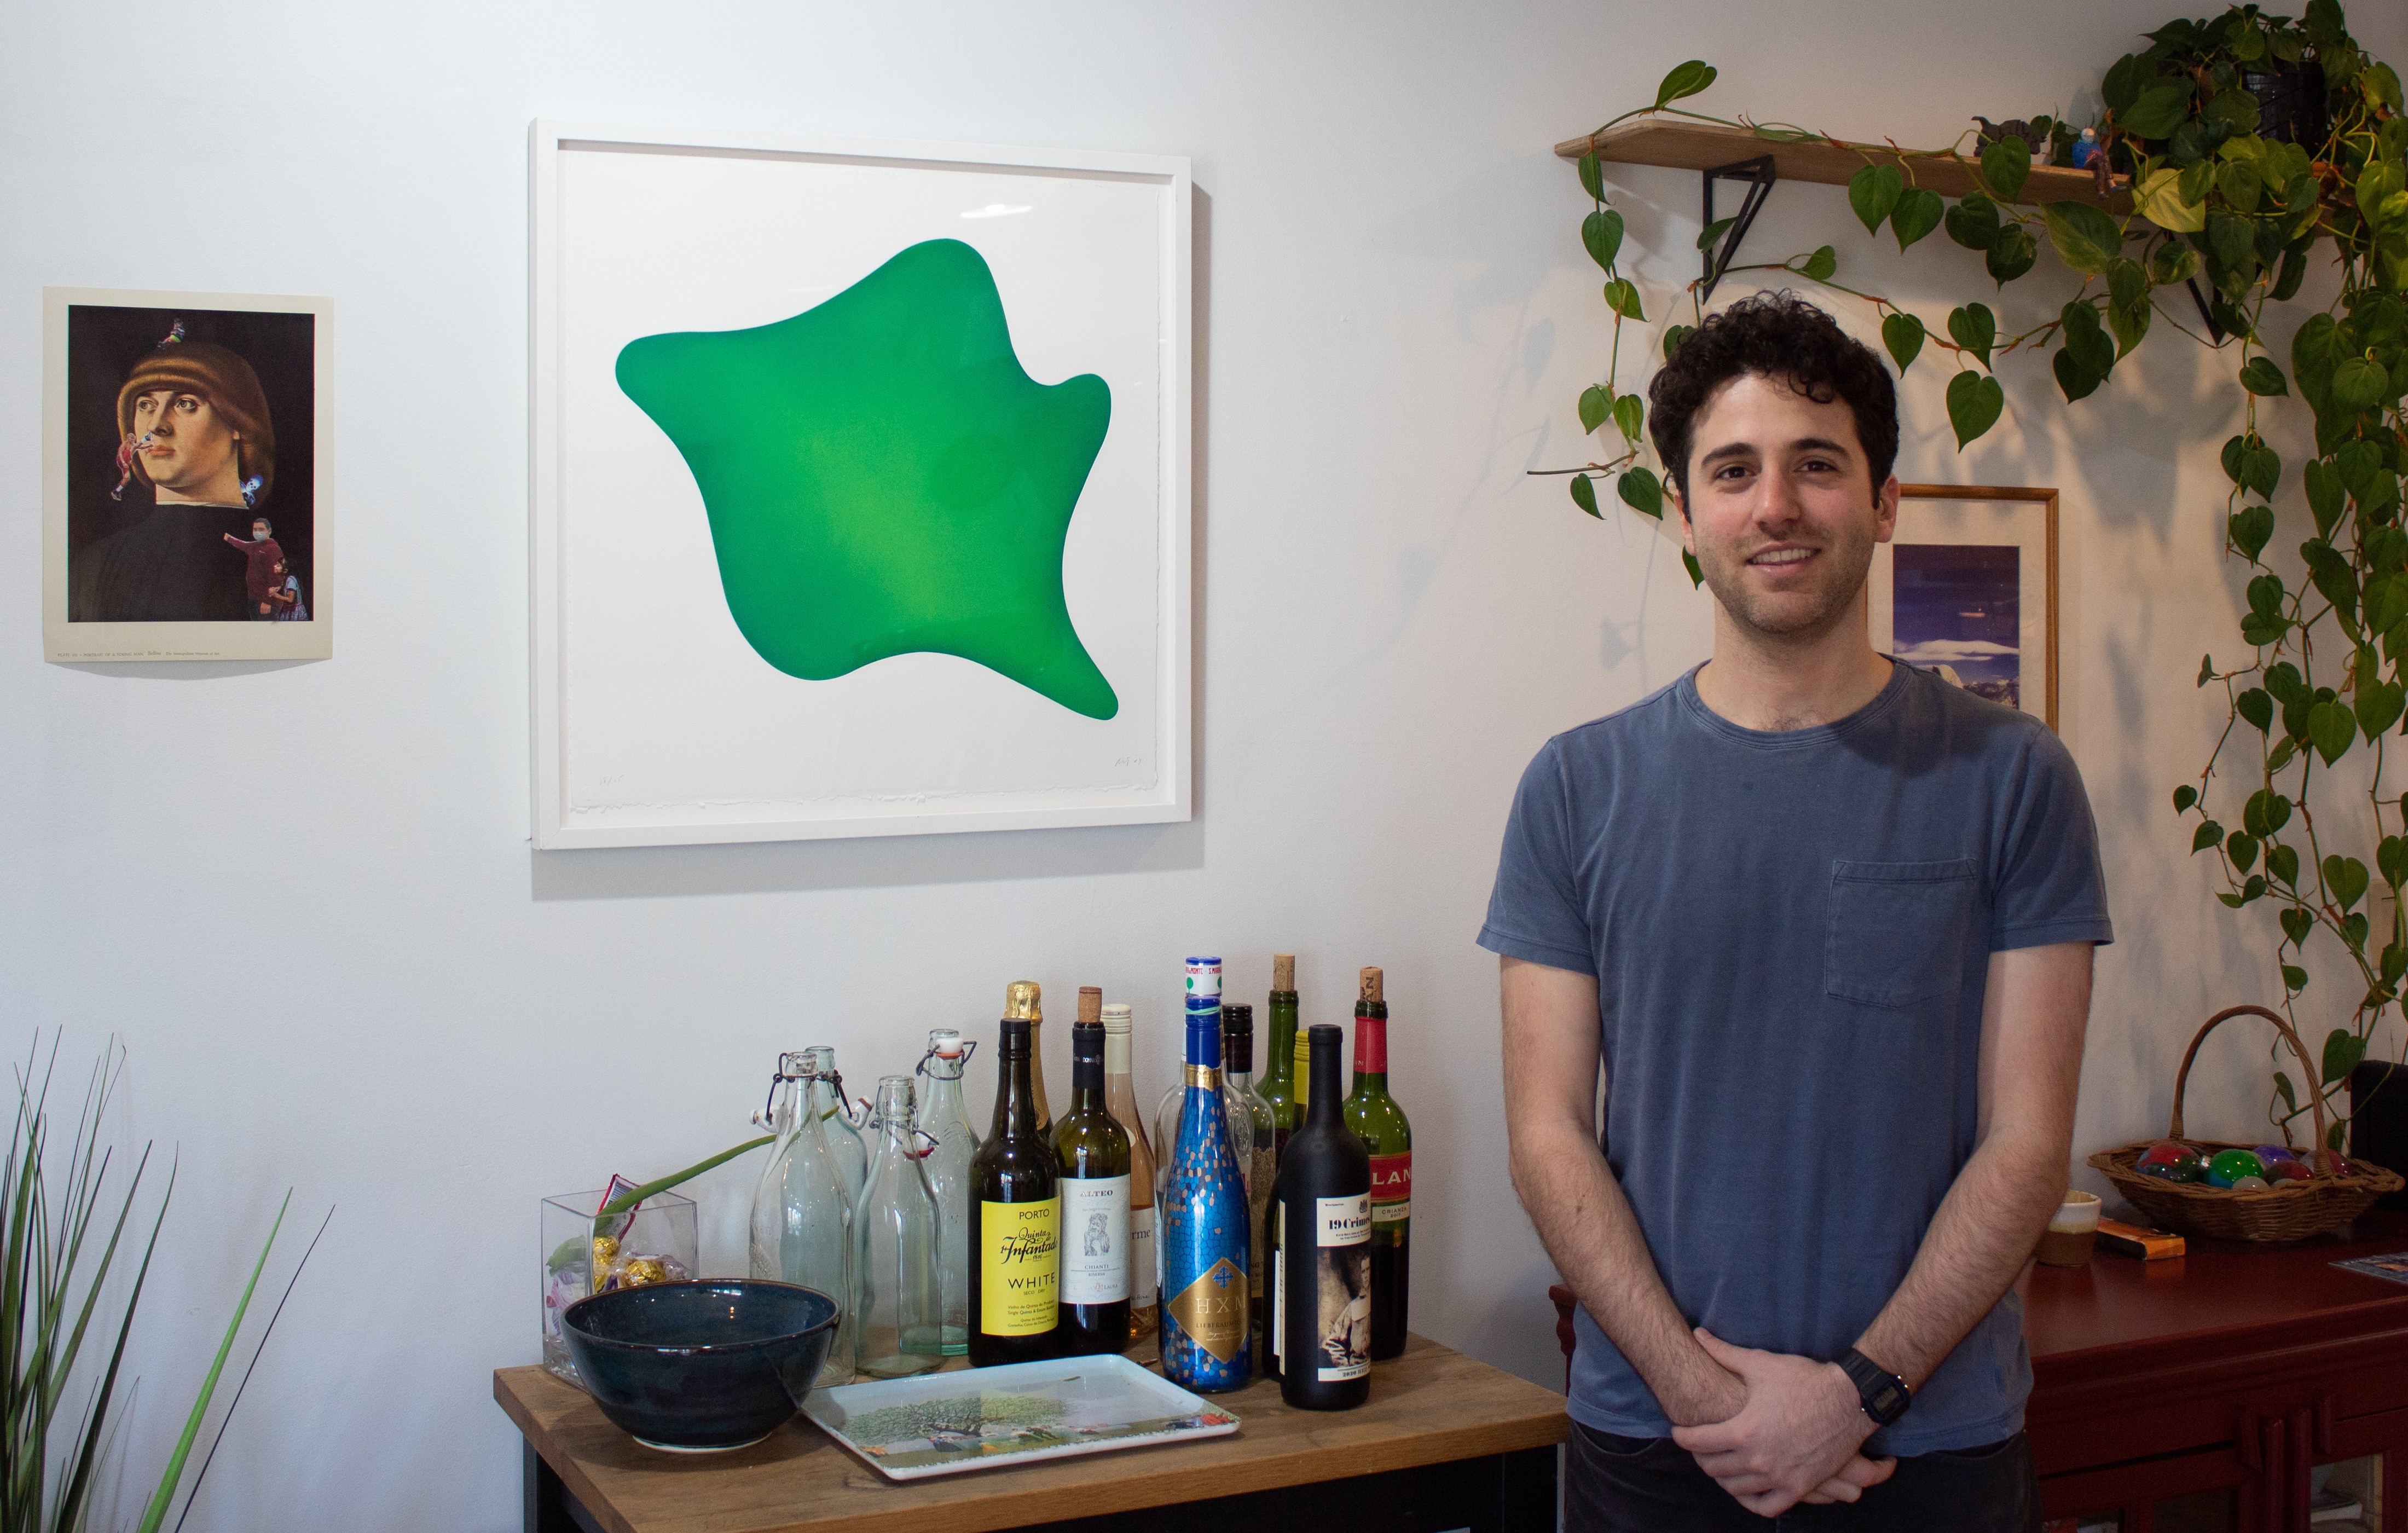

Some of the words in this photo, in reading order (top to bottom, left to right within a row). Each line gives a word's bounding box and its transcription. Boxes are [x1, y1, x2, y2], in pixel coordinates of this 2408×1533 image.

[1372, 1167, 1411, 1185] LAN
[1019, 1208, 1050, 1220] PORTO
[1329, 1219, 1342, 1230] 19
[1343, 1217, 1370, 1229] Crime
[1018, 1227, 1048, 1242] Quinta
[1008, 1272, 1055, 1289] WHITE
